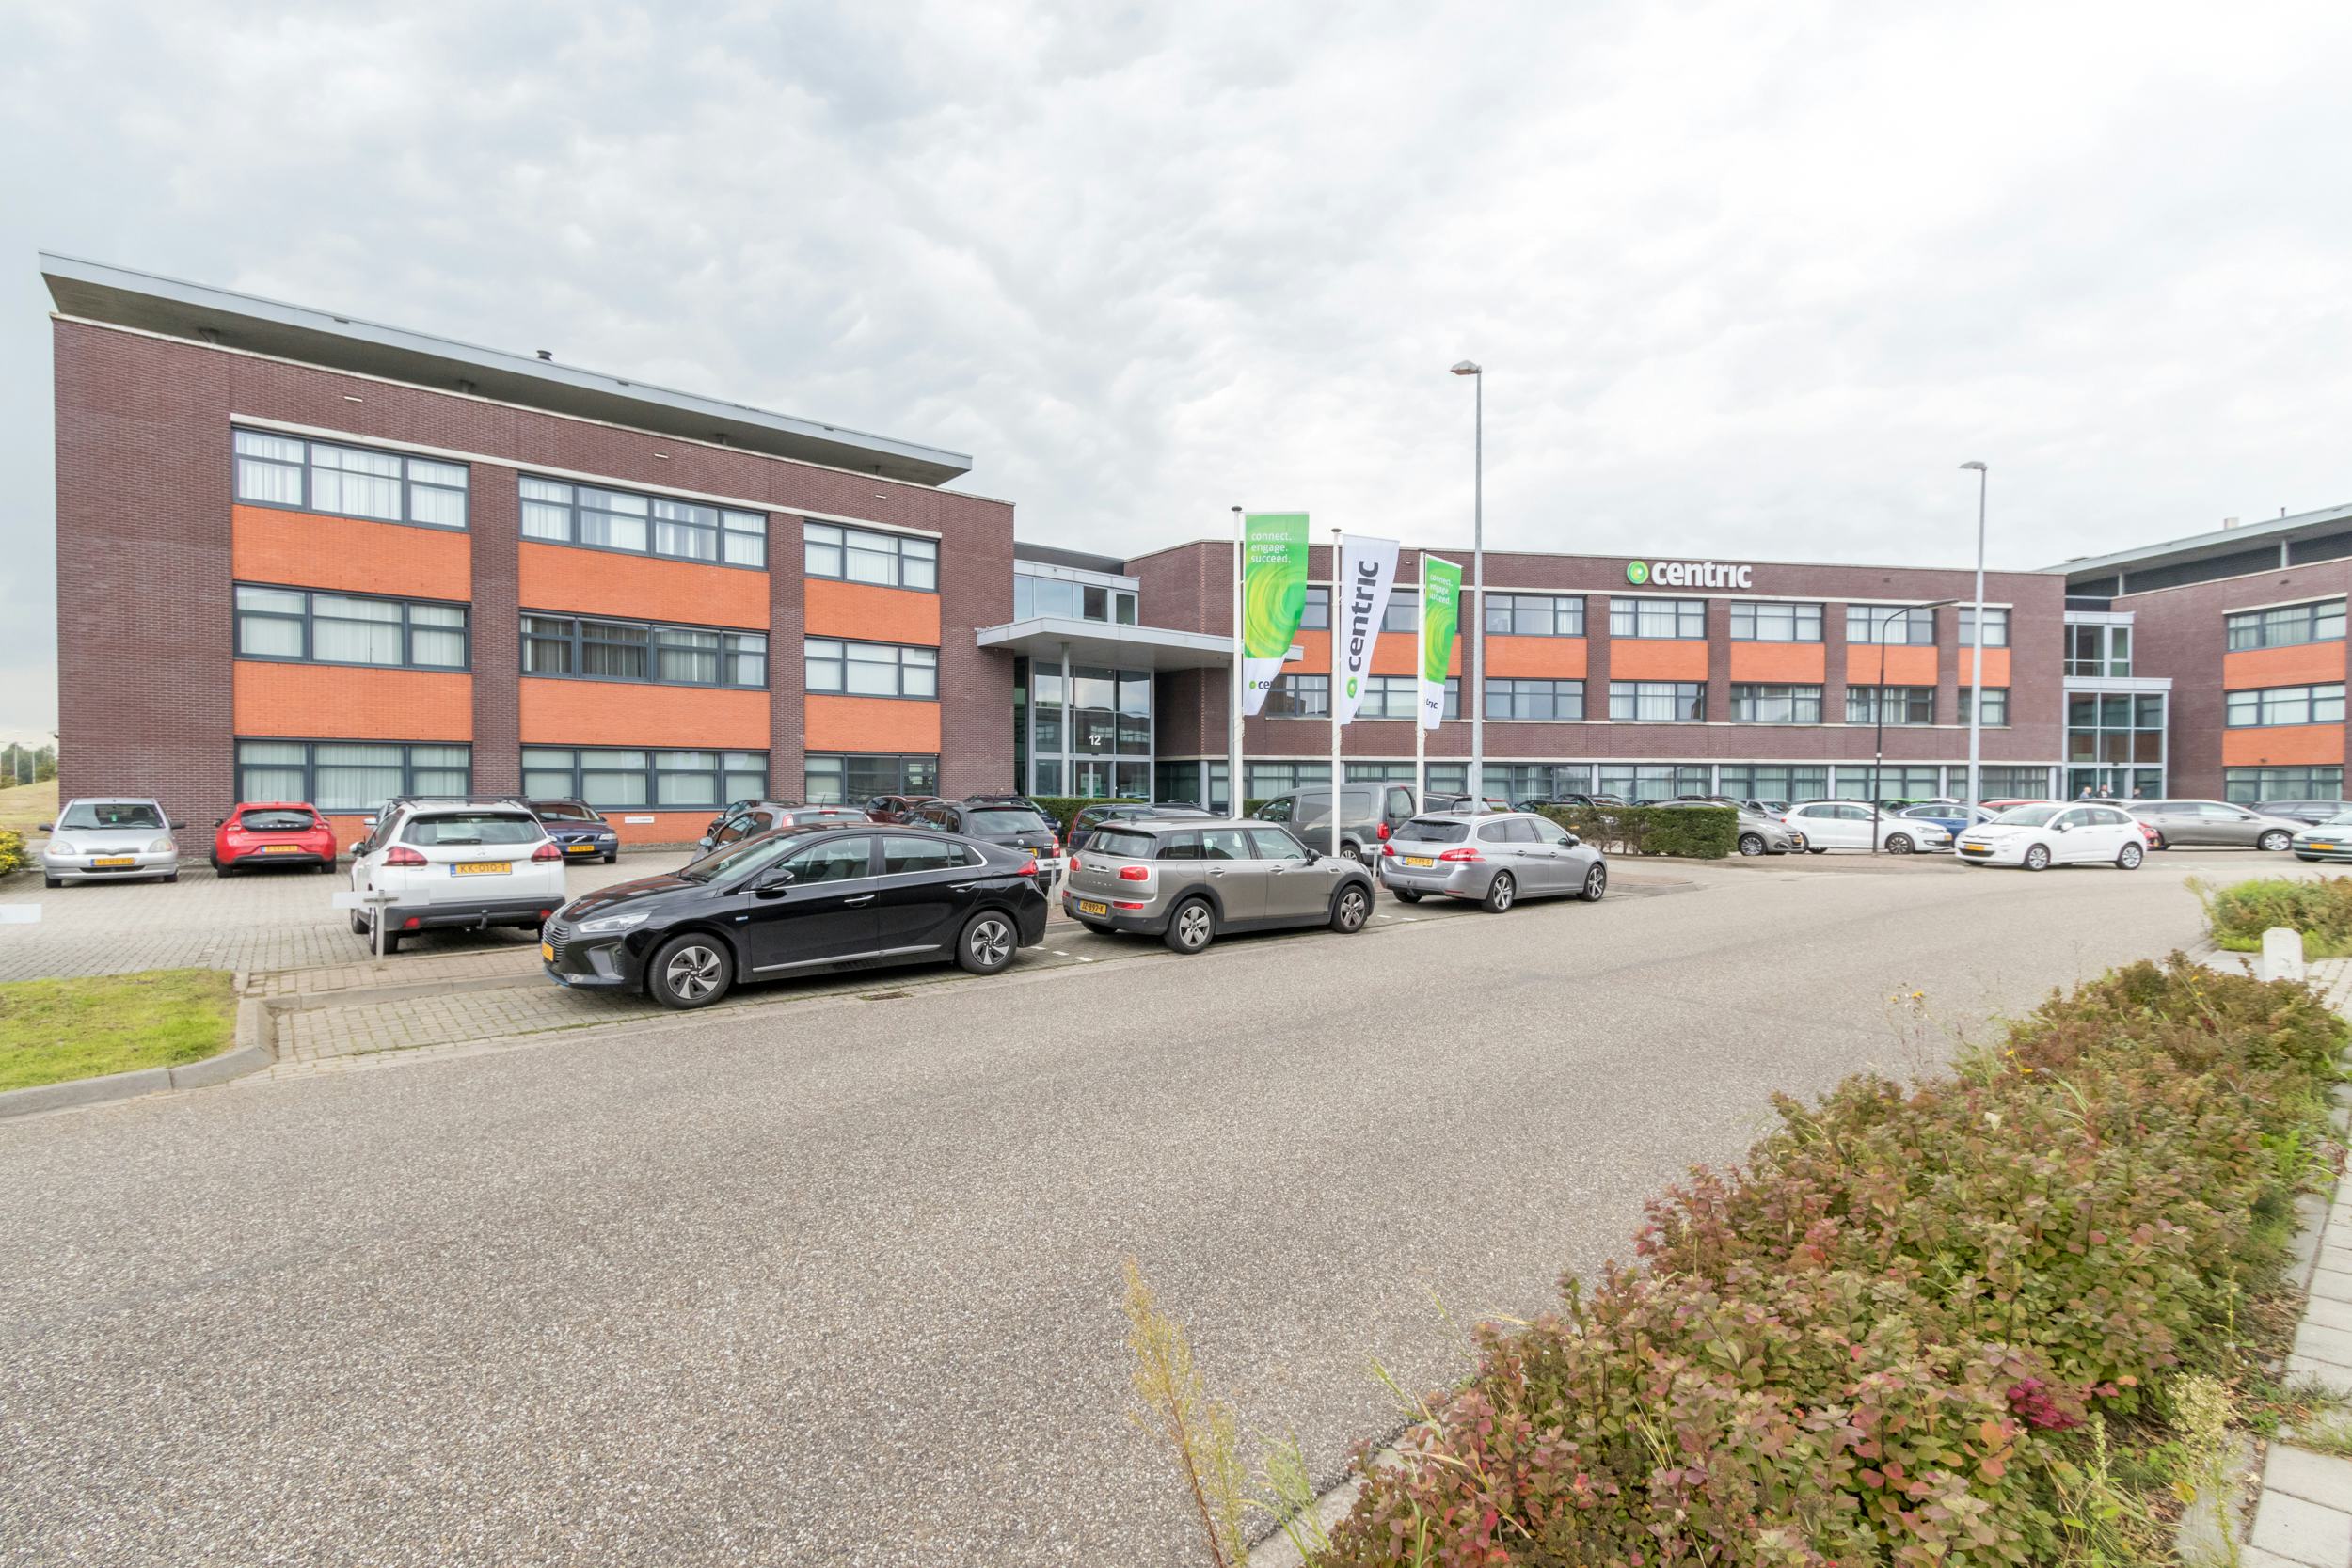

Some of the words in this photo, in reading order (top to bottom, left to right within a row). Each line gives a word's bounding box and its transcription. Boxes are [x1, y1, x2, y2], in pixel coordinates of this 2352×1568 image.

[1250, 532, 1292, 542] connect.
[1250, 543, 1288, 554] engage.
[1250, 554, 1292, 563] succeed.
[1651, 561, 1752, 588] centric
[1348, 560, 1379, 673] centric
[1089, 734, 1102, 746] 12
[460, 863, 506, 874] KK-010-T
